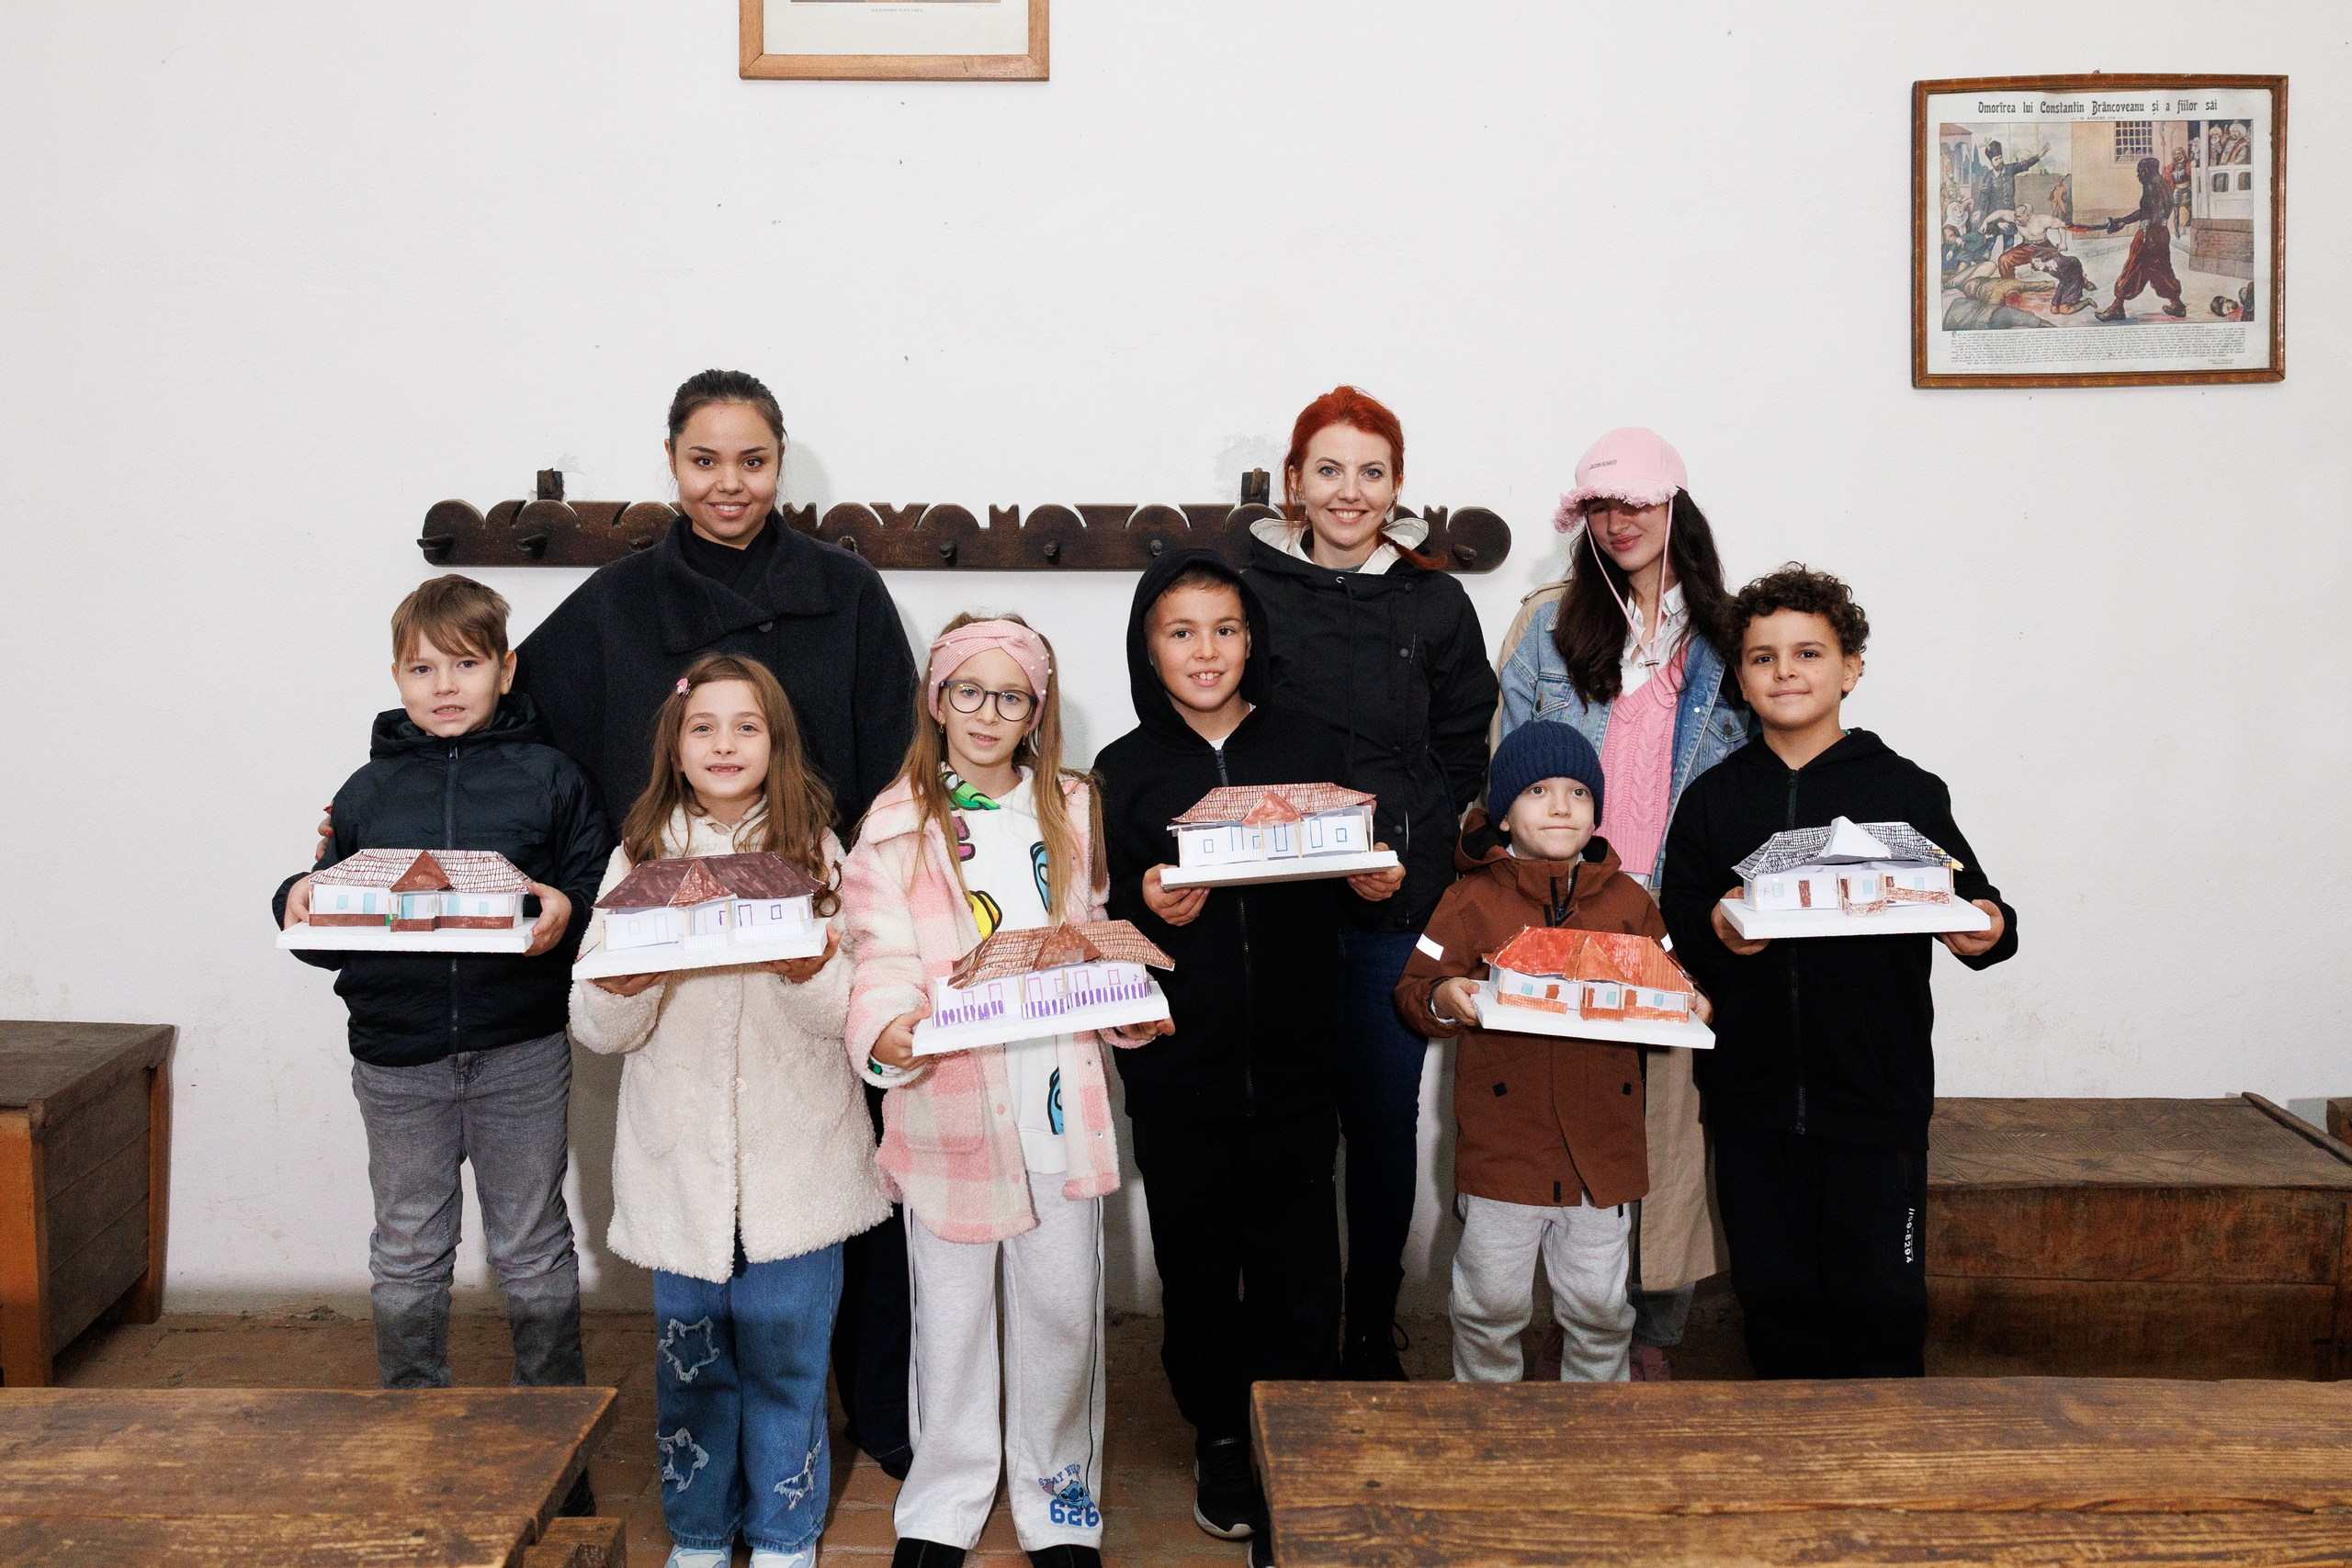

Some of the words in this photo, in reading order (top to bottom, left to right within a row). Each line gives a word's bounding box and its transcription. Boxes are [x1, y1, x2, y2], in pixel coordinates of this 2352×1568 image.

[1977, 101, 2016, 114] Omorîrea
[2022, 101, 2033, 114] lui
[2040, 101, 2085, 114] Constantin
[2091, 100, 2144, 116] Brâncoveanu
[2165, 102, 2170, 112] a
[2177, 99, 2199, 115] fiilor
[1050, 1499, 1099, 1527] 626
